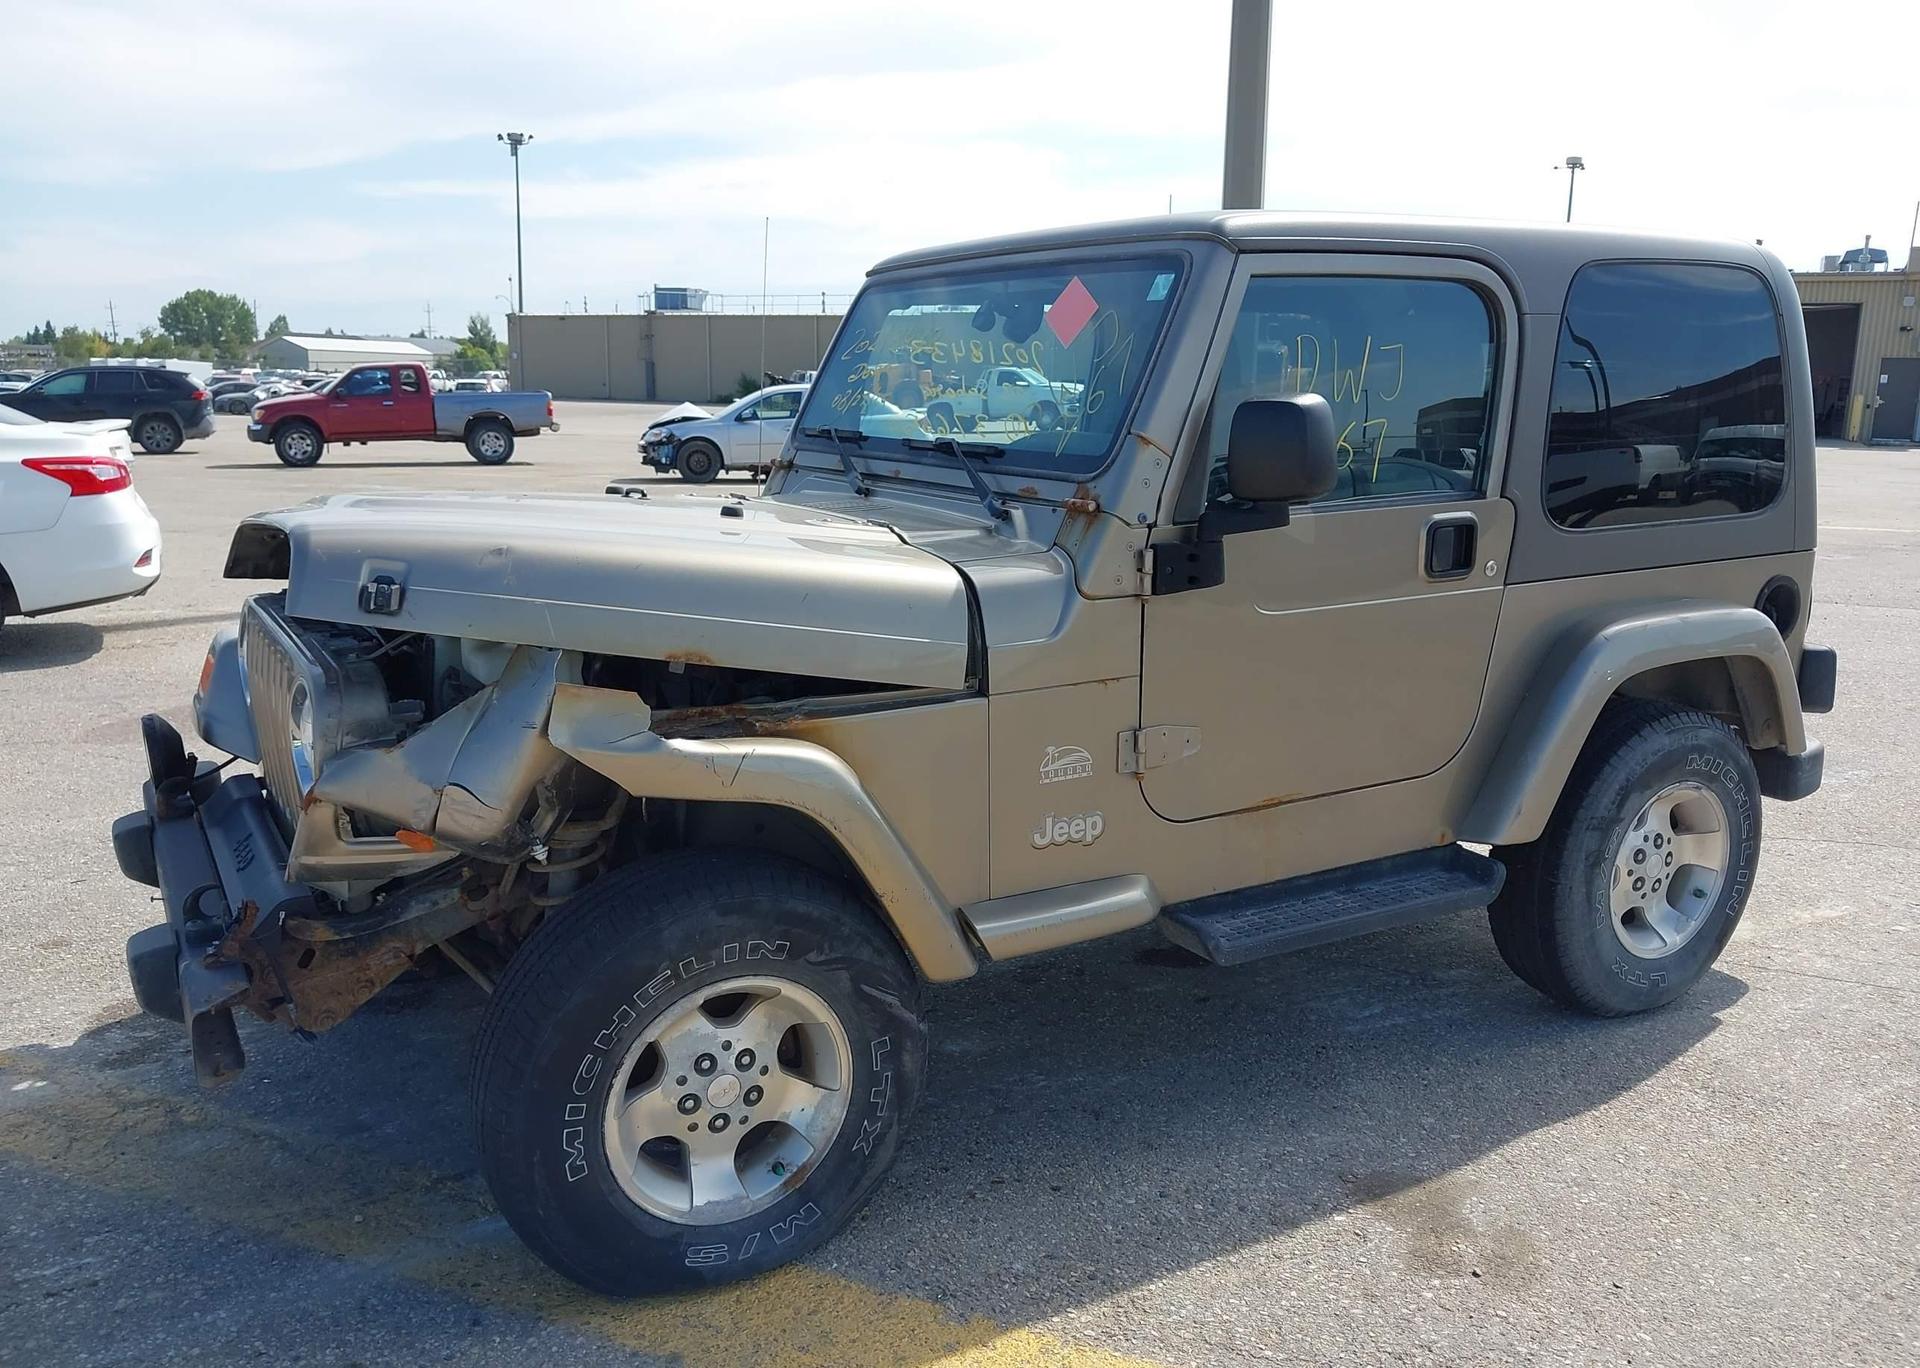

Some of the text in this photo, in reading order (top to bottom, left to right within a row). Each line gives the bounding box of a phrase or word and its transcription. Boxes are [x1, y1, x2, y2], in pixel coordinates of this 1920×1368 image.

[1040, 763, 1092, 781] SAHARA
[1032, 812, 1104, 848] Jeep
[1686, 754, 1753, 916] MICHELIN
[1612, 956, 1668, 988] LTX
[563, 939, 891, 1268] MICHELIN LTX M/S
